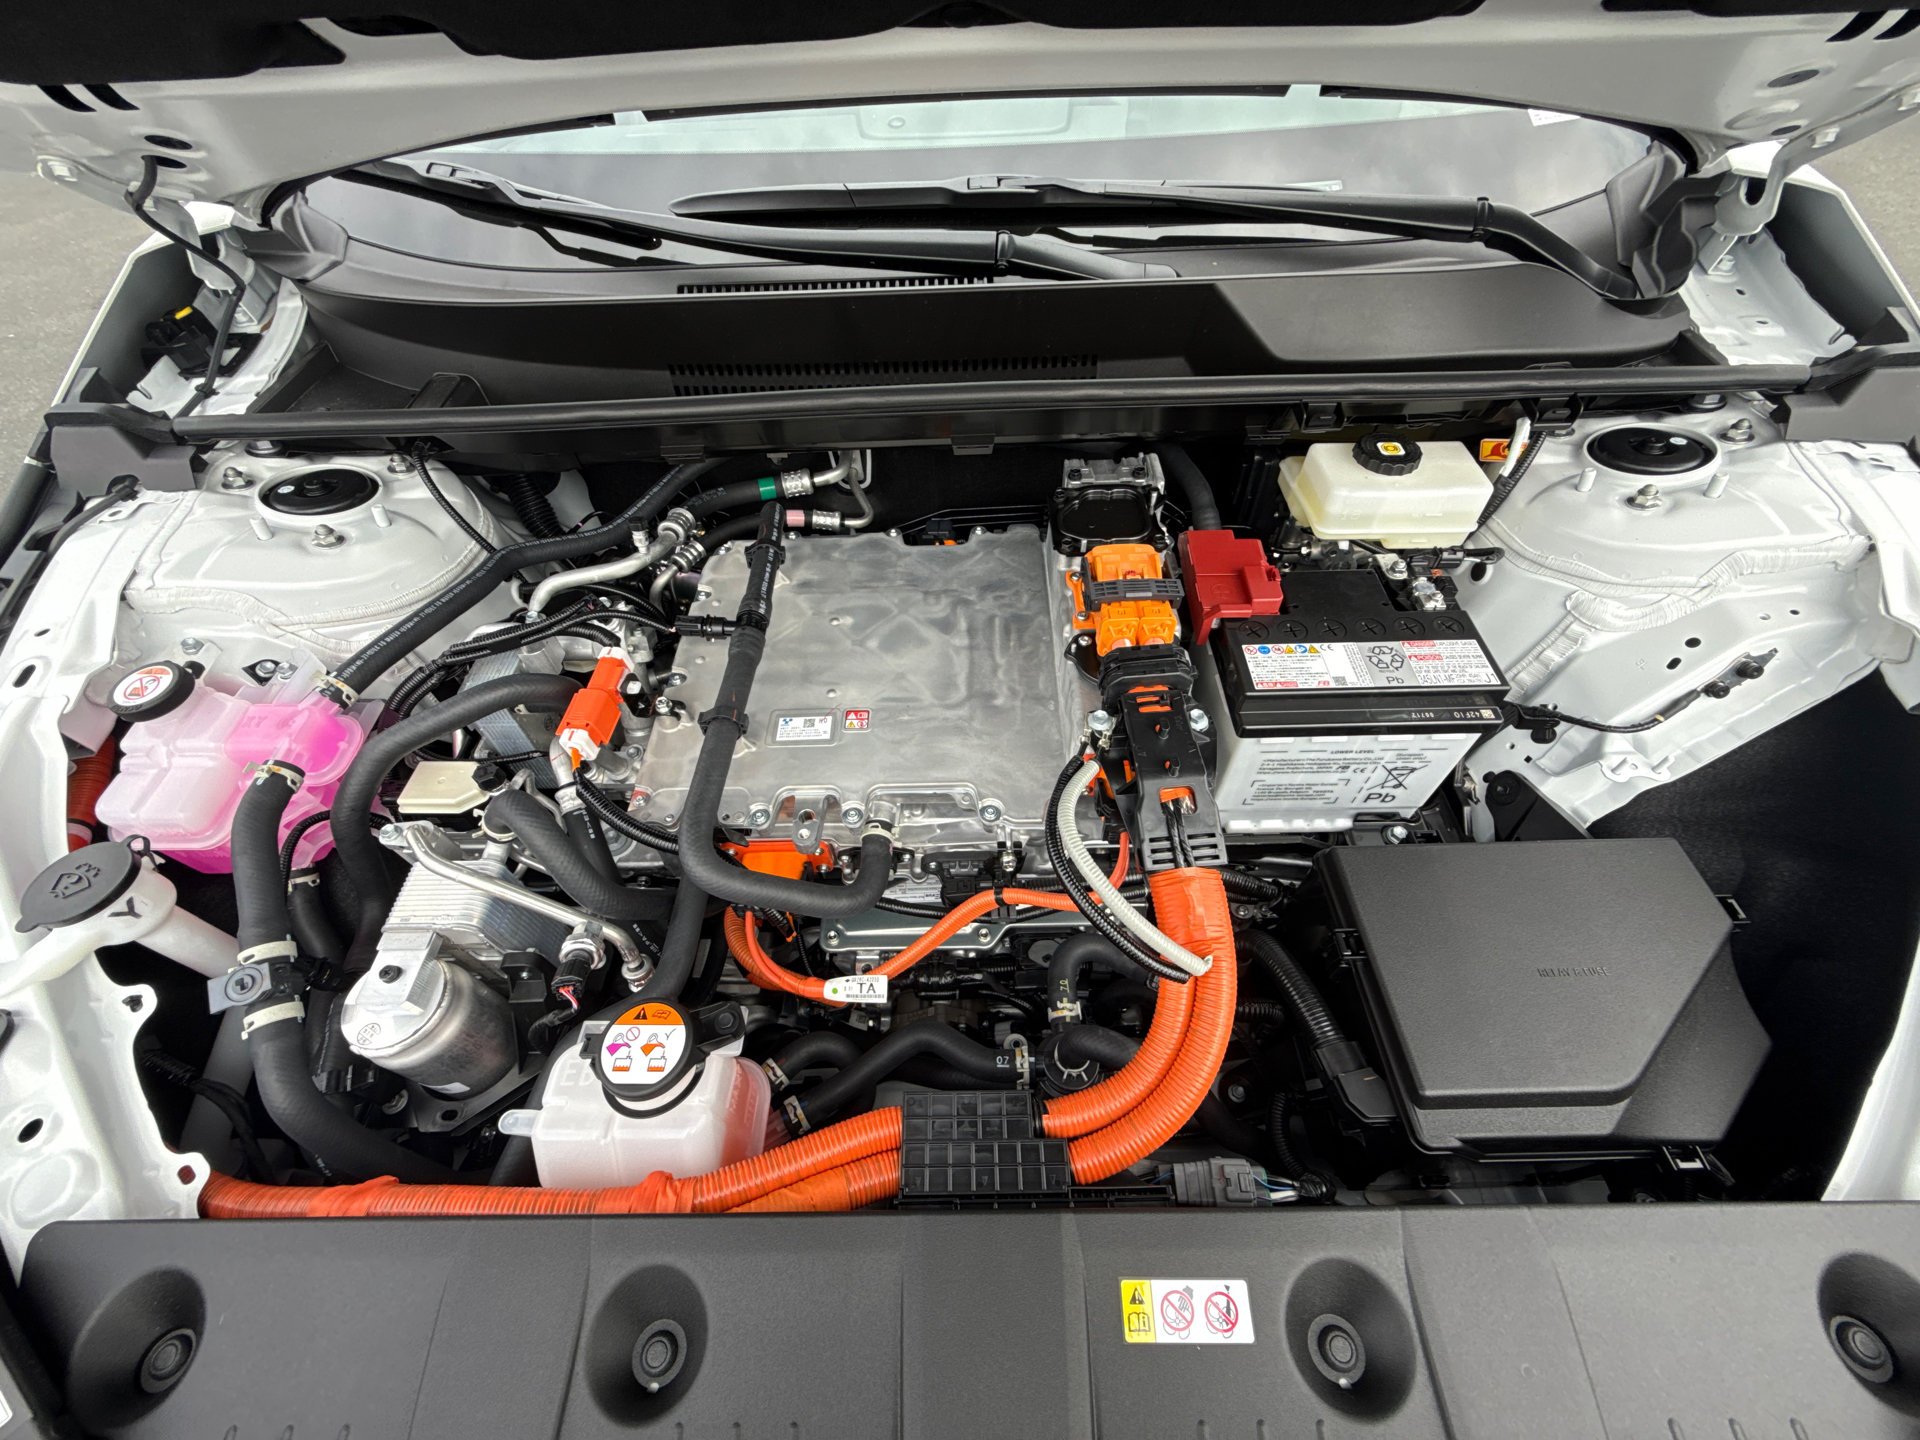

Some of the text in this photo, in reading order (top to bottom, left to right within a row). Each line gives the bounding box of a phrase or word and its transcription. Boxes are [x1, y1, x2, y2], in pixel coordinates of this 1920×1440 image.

[1386, 676, 1405, 684] Pb
[1363, 792, 1396, 803] Pb
[857, 982, 876, 994] TA
[996, 1055, 1010, 1065] 07
